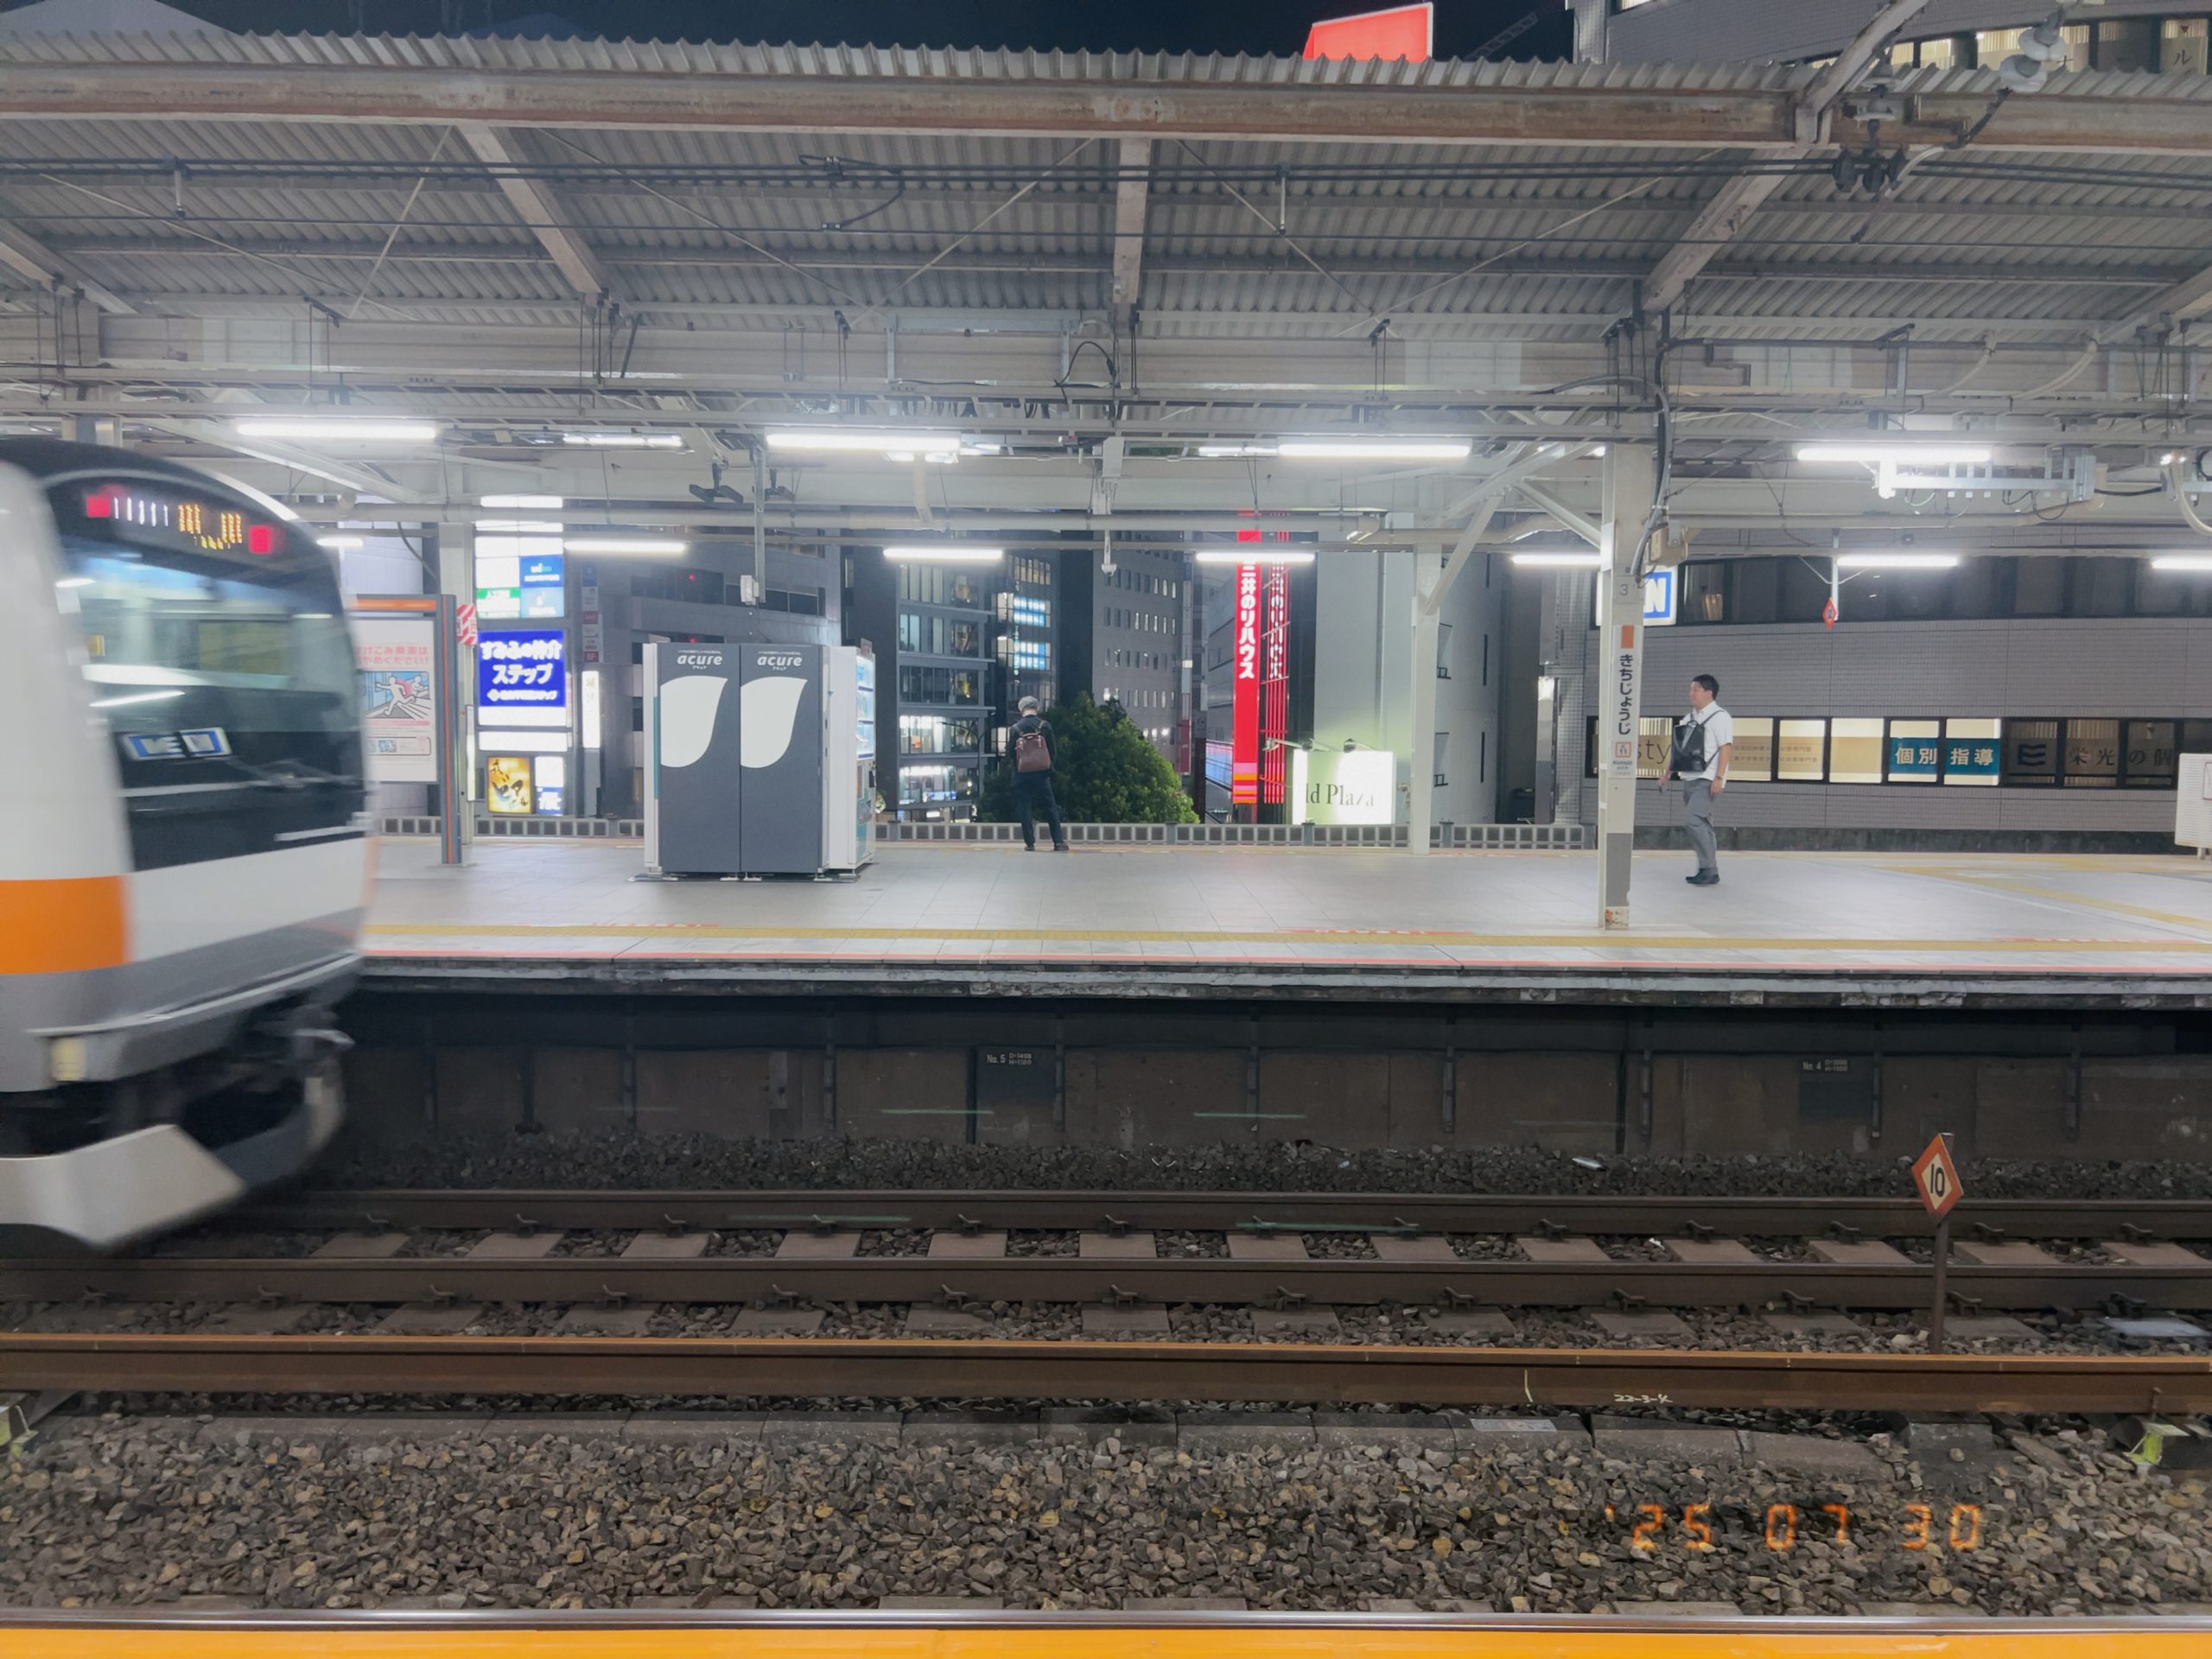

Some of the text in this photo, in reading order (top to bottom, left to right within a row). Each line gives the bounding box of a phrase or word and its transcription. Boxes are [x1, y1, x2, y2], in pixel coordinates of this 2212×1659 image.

[1238, 561, 1256, 679] 三井のリハウス
[677, 655, 722, 665] acure
[757, 656, 803, 667] acure
[492, 663, 553, 684] ステップ
[1618, 654, 1633, 735] きちじょうじ
[1895, 747, 1993, 766] 個別指導
[1930, 1163, 1945, 1198] 10
